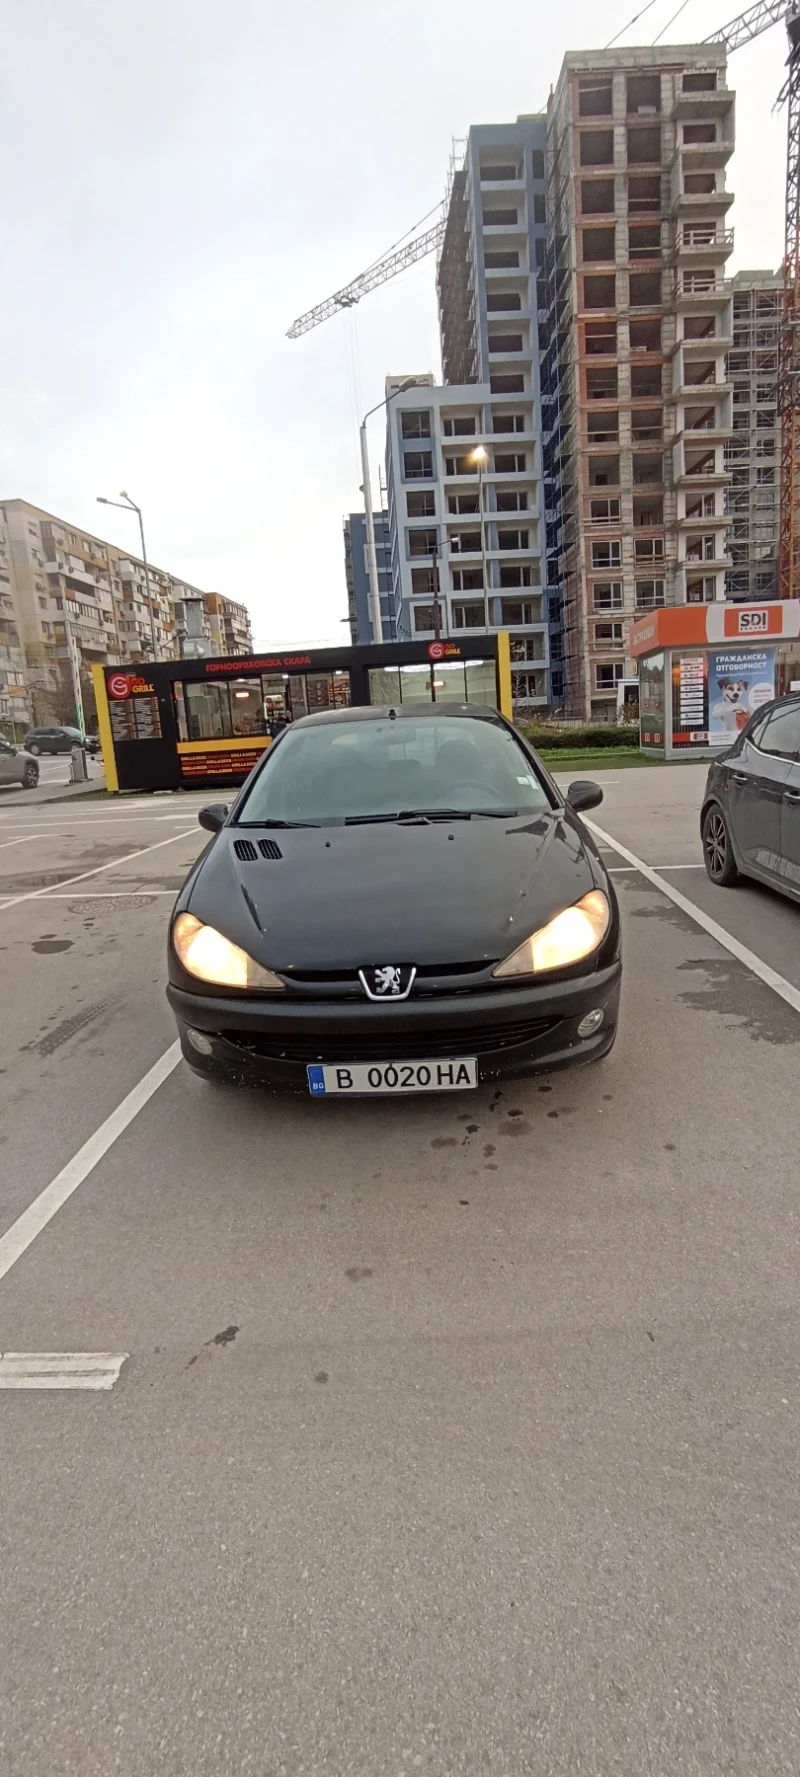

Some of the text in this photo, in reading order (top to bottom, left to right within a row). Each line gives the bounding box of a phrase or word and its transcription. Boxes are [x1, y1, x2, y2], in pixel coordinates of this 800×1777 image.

[740, 612, 766, 627] SDI
[715, 653, 767, 663] ГРАЖДАНСКА
[205, 656, 312, 672] ГОРНООРЯХОВСКА СКАРА
[715, 661, 767, 672] ОТГОВОРНОСТ
[131, 677, 145, 685] GO
[132, 684, 154, 693] GRILL
[336, 1064, 471, 1088] B 0020 HA
[313, 1082, 325, 1090] BG
